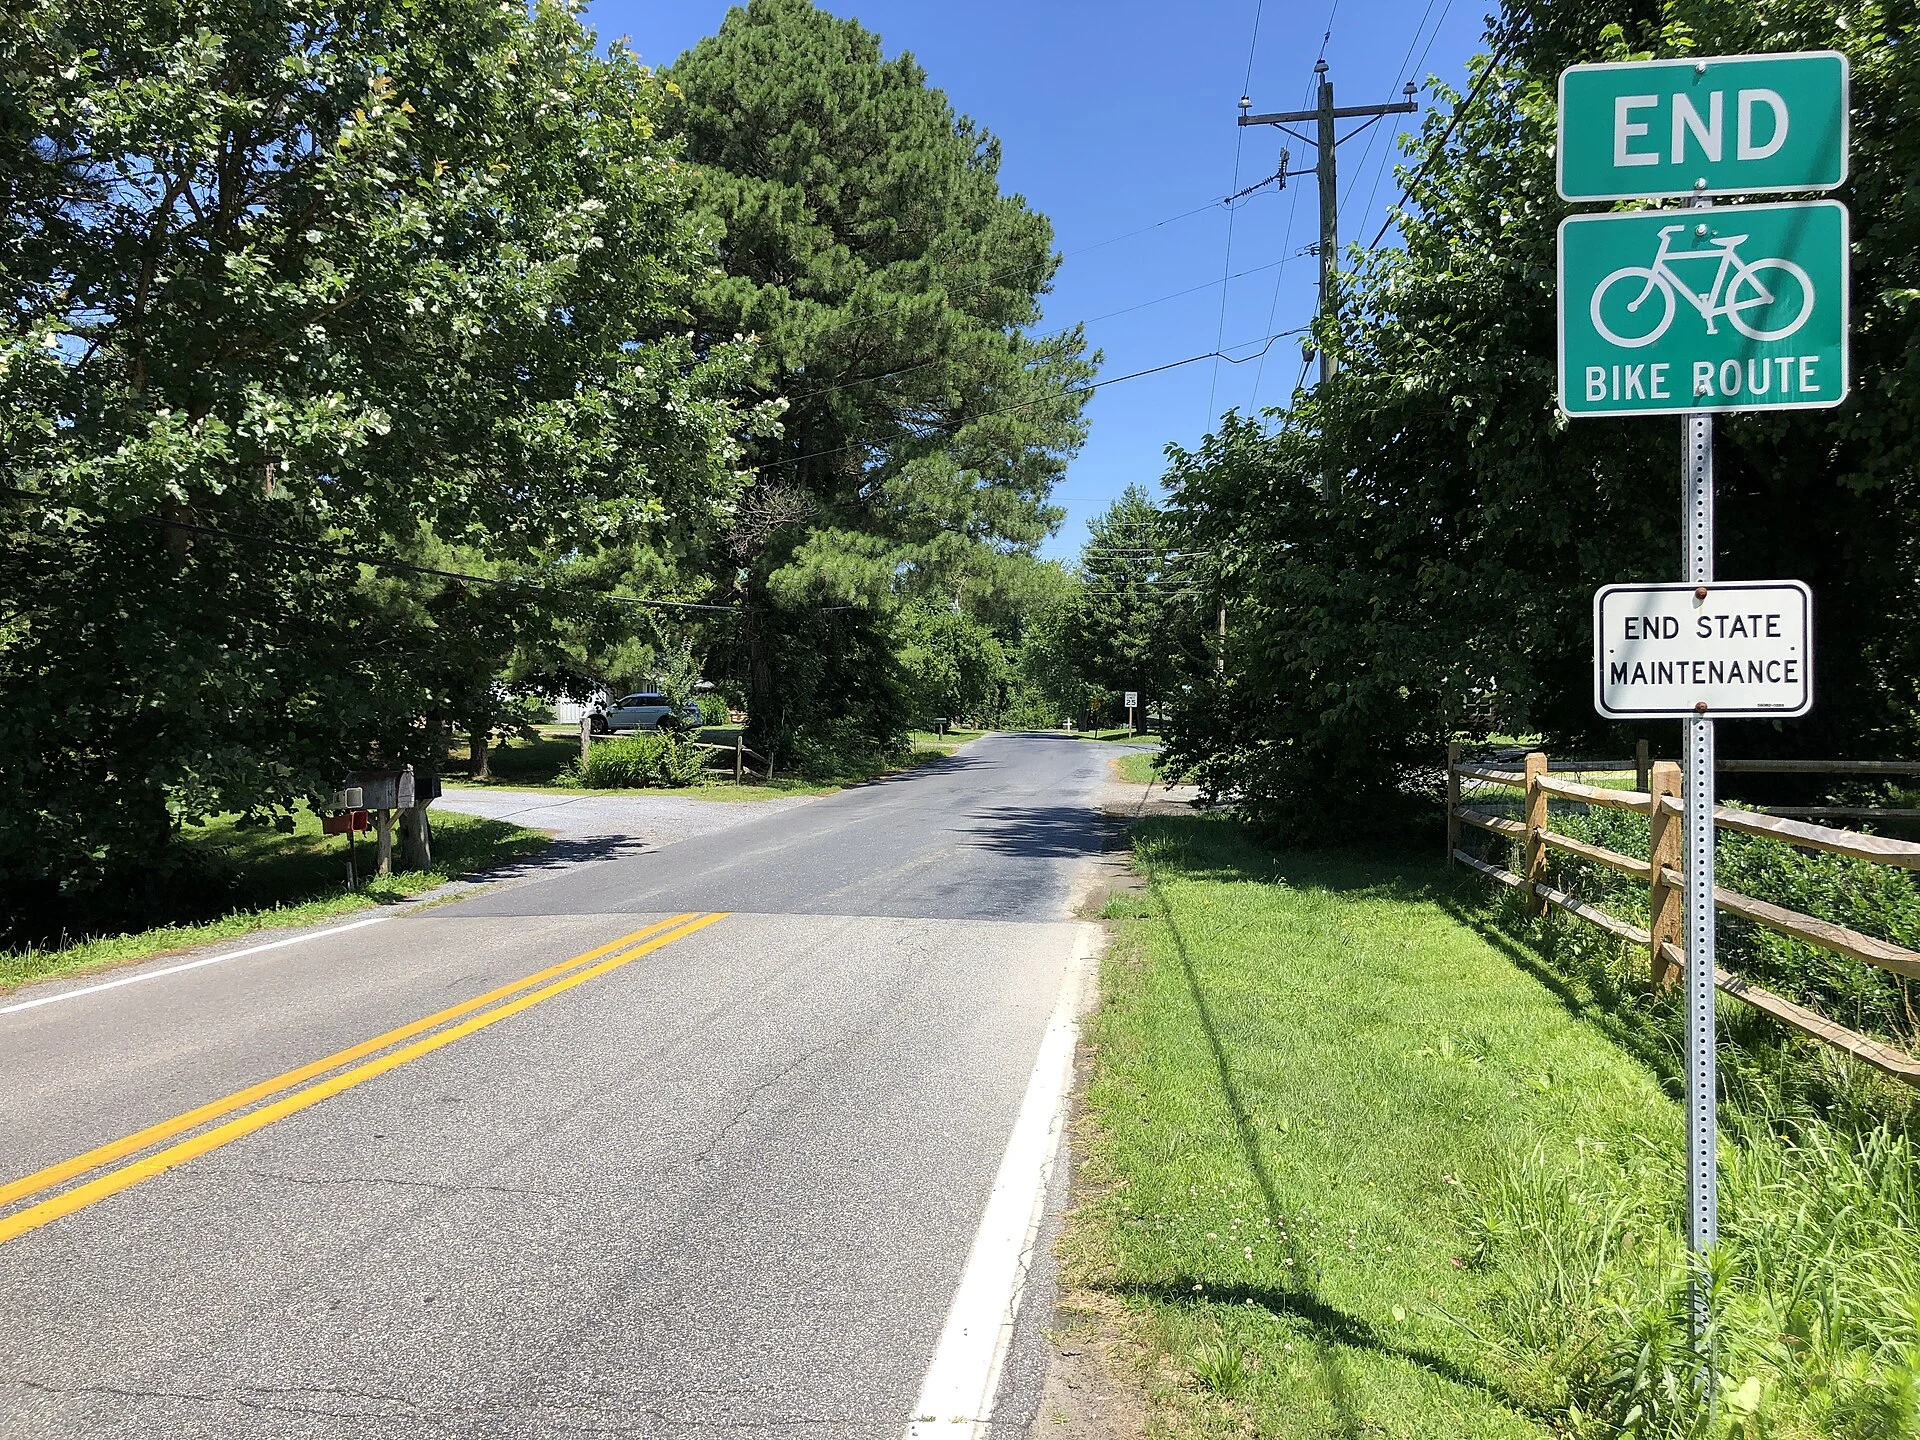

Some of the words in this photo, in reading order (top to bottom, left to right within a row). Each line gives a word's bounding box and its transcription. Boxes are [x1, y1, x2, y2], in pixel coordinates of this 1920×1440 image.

[1613, 88, 1790, 168] END
[1585, 362, 1671, 402] BIKE
[1693, 355, 1820, 397] ROUTE
[1624, 616, 1679, 640] END
[1696, 614, 1781, 639] STATE
[1610, 659, 1798, 685] MAINTENANCE
